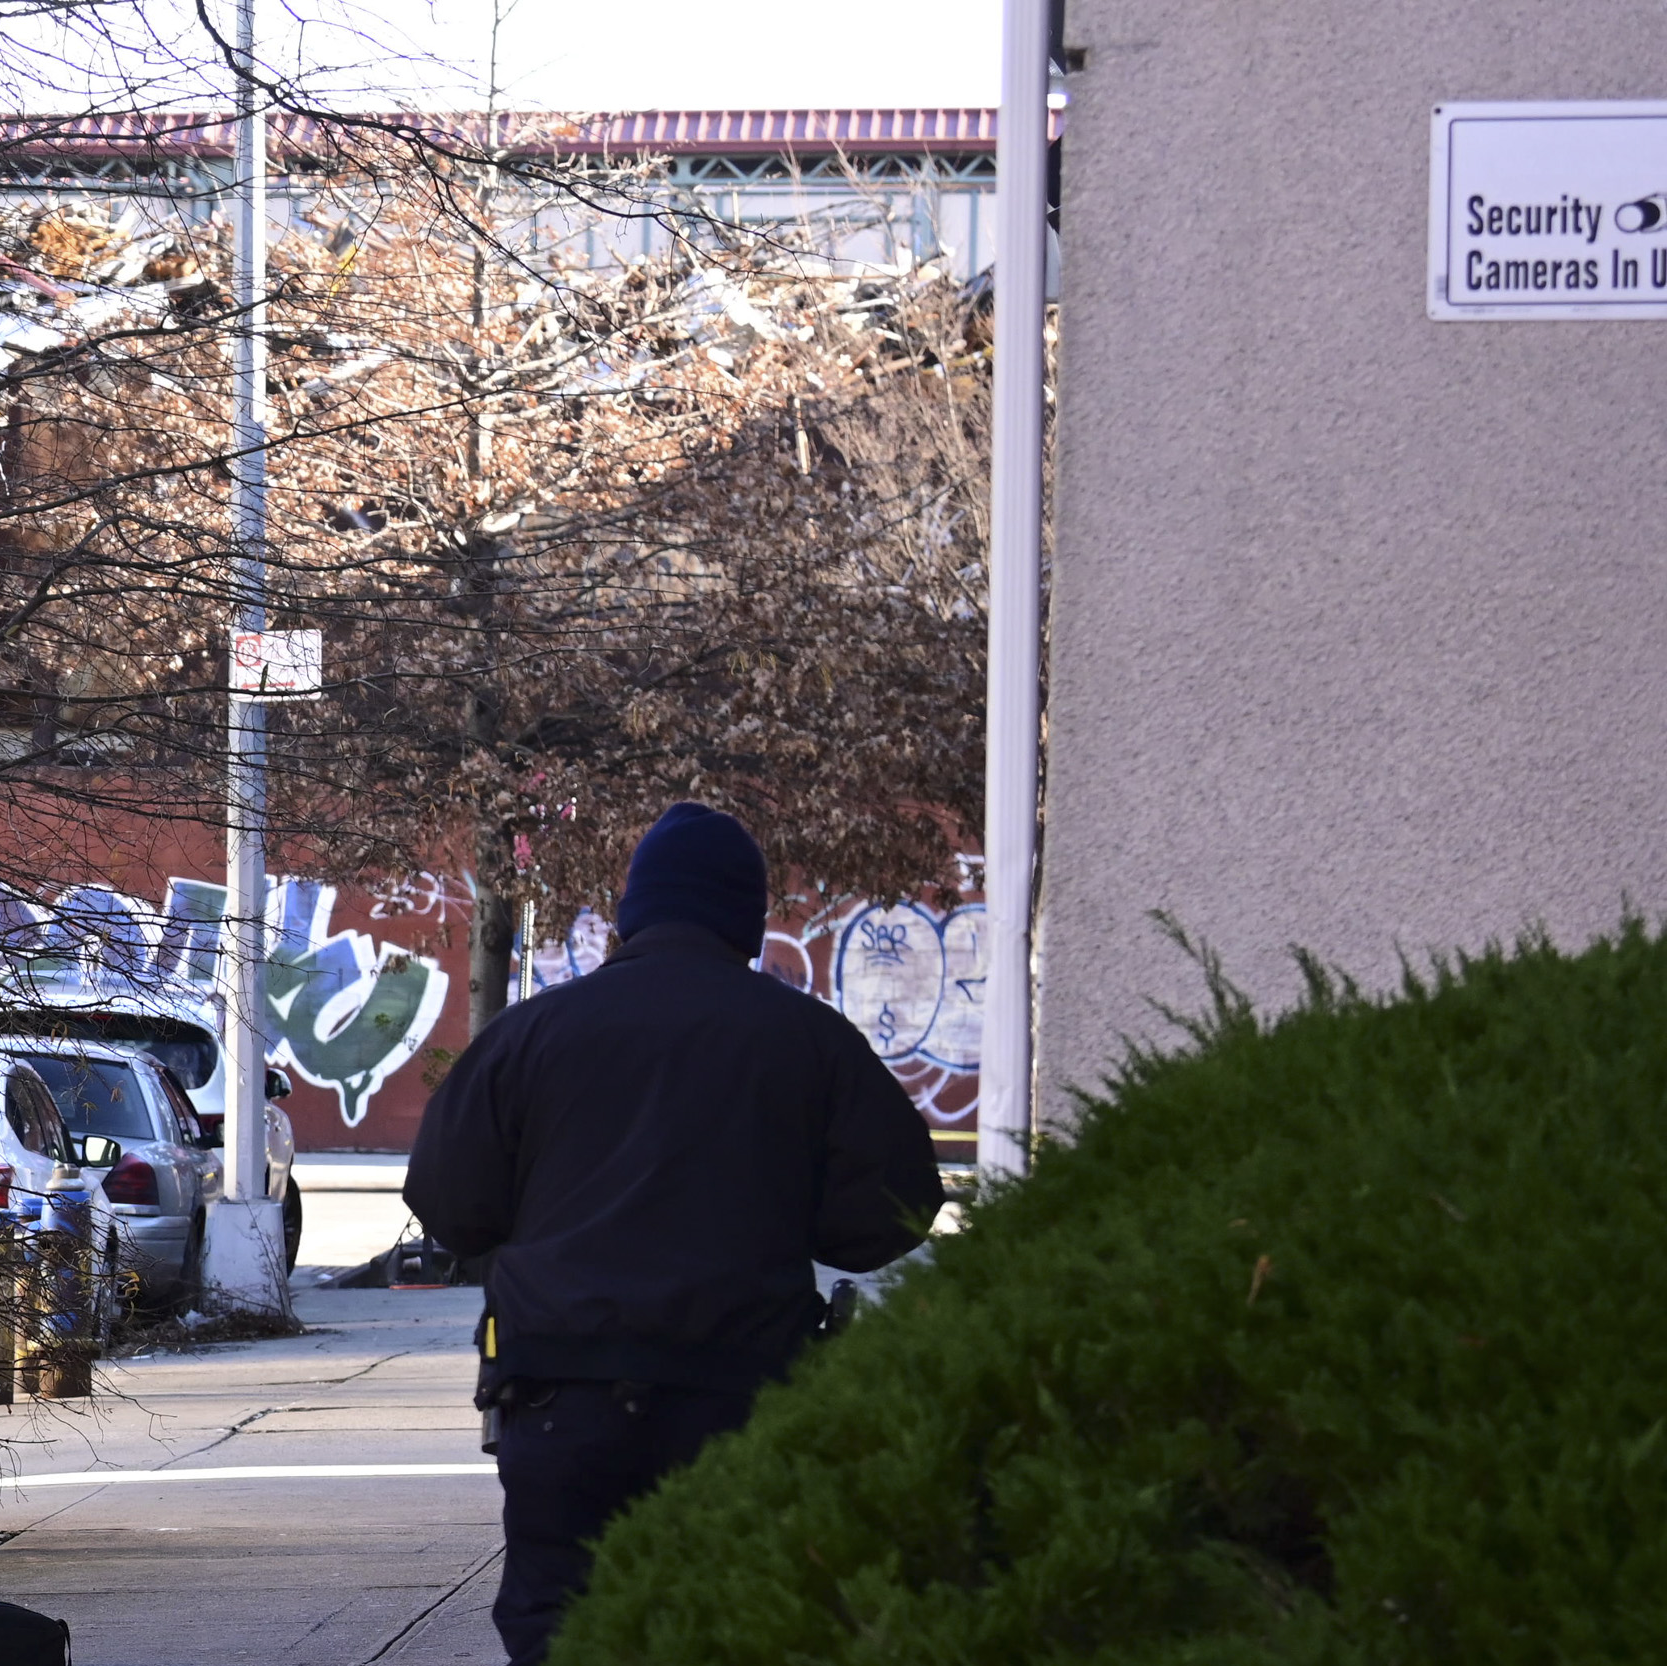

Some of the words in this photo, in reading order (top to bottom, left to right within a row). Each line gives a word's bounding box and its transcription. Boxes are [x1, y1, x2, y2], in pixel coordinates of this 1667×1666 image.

[1467, 194, 1602, 244] Security
[1466, 249, 1599, 291] Cameras
[1612, 248, 1639, 288] In
